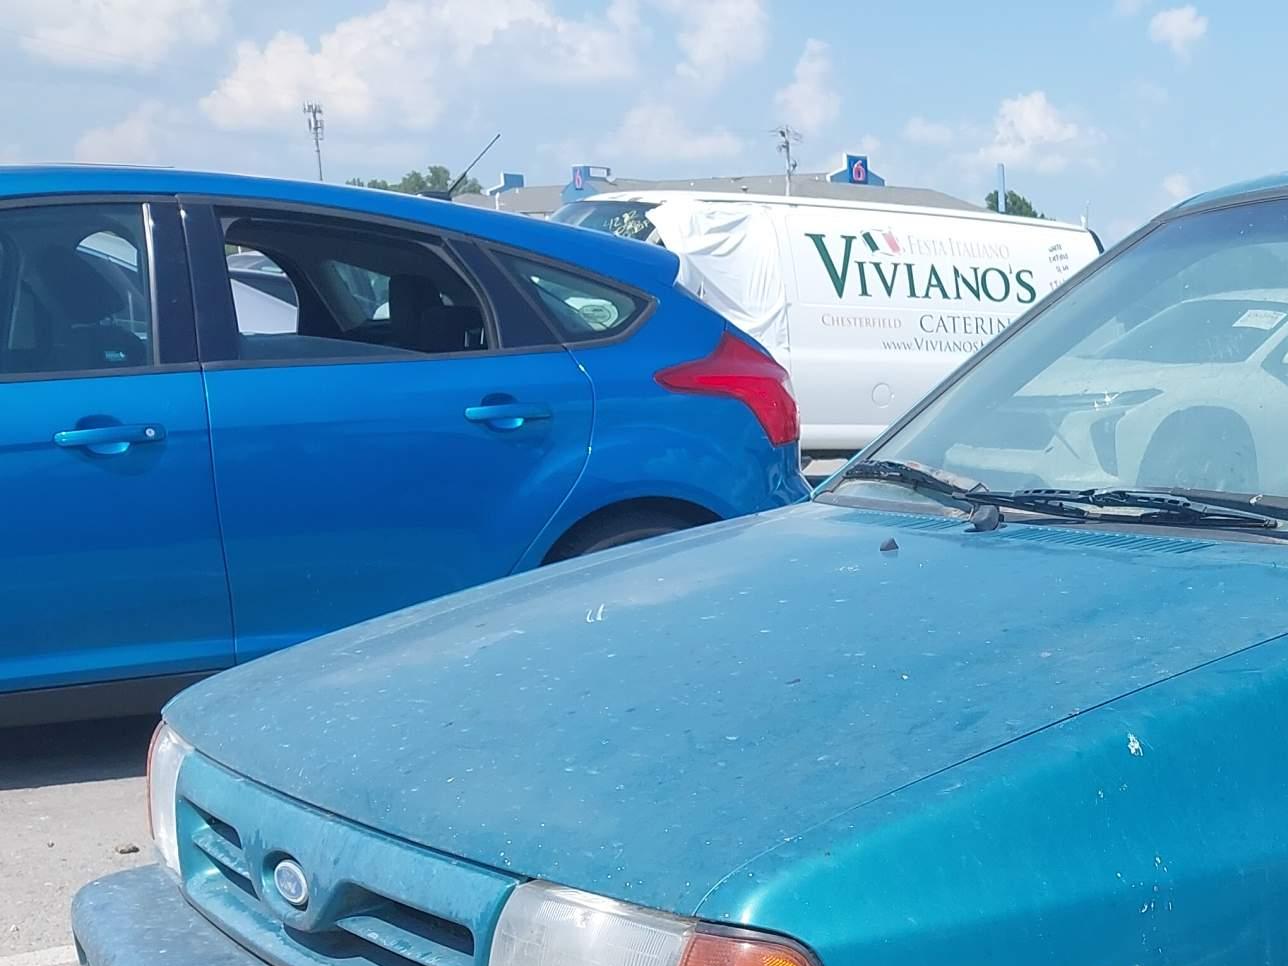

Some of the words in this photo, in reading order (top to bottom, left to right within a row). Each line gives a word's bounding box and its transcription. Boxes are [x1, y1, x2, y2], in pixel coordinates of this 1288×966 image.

[853, 160, 865, 181] 6
[804, 233, 1037, 304] VIVIANO'S
[919, 313, 1011, 335] CATERIN
